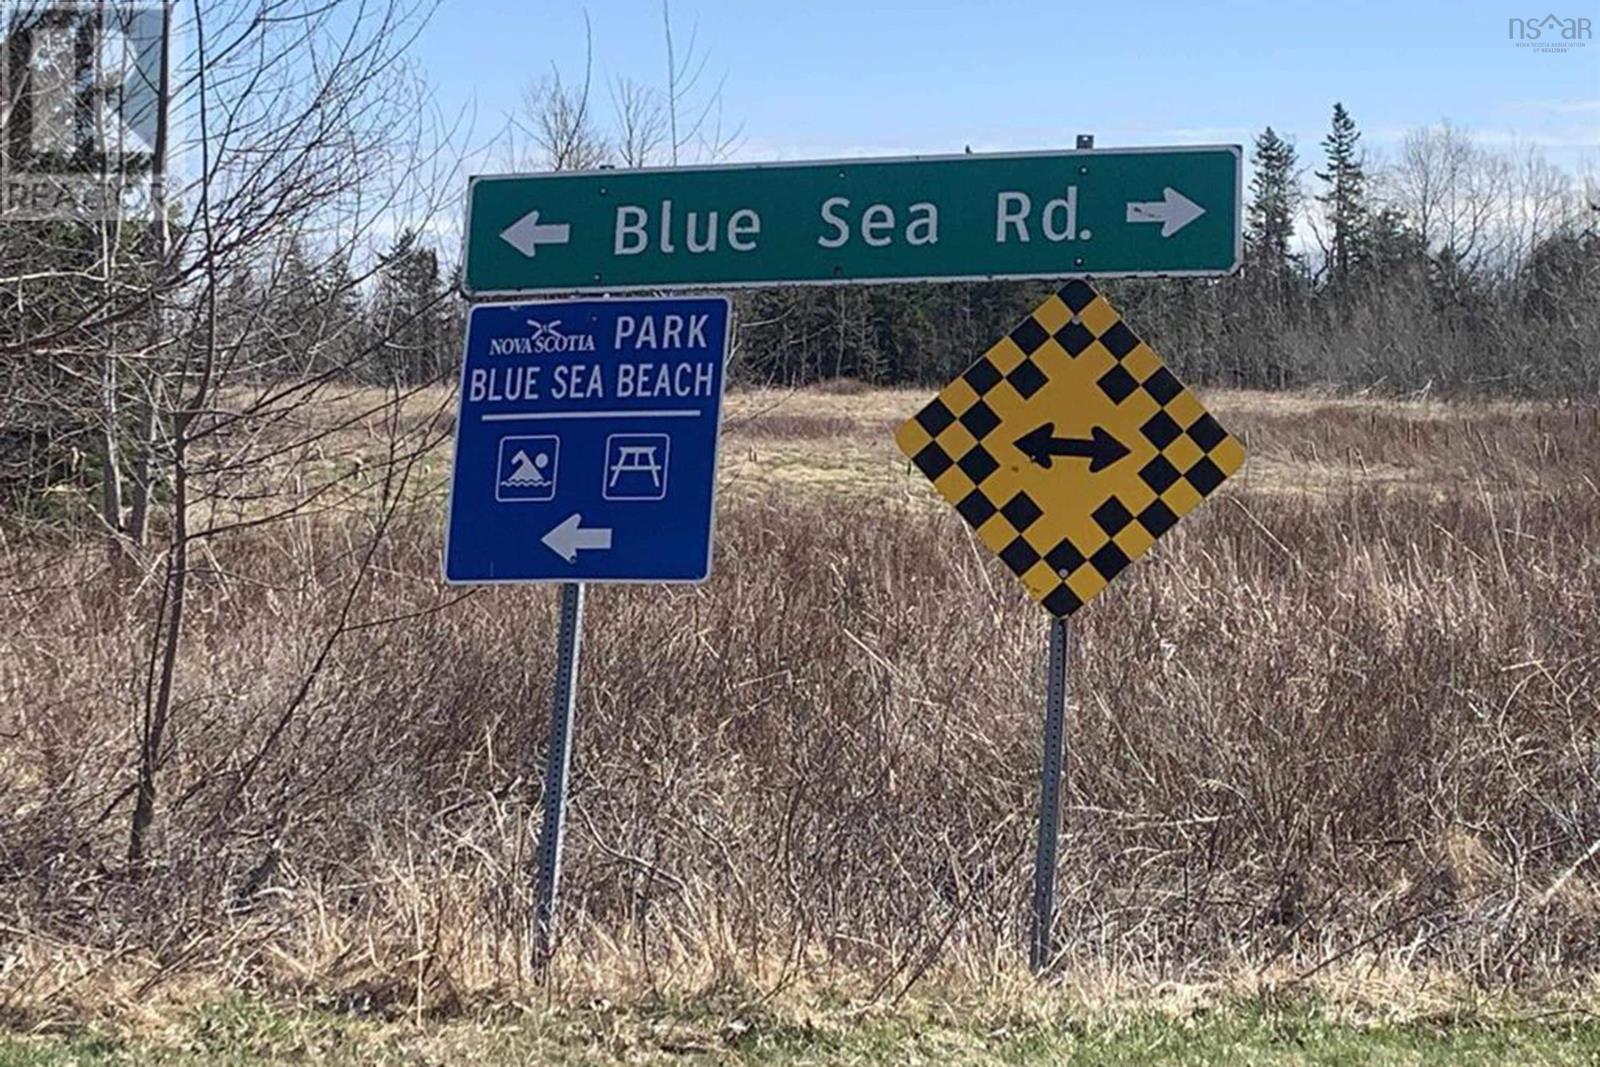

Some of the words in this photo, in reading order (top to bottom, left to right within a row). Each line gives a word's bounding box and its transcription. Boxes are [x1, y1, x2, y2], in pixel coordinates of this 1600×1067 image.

[614, 200, 761, 255] Blue
[818, 197, 939, 248] Sea
[996, 186, 1092, 243] Rd.
[490, 337, 533, 355] NOVA
[534, 334, 596, 353] SCOTIA
[615, 314, 709, 349] PARK
[469, 366, 540, 402] BLUE
[551, 364, 604, 399] SEA
[616, 362, 714, 398] BEACH
